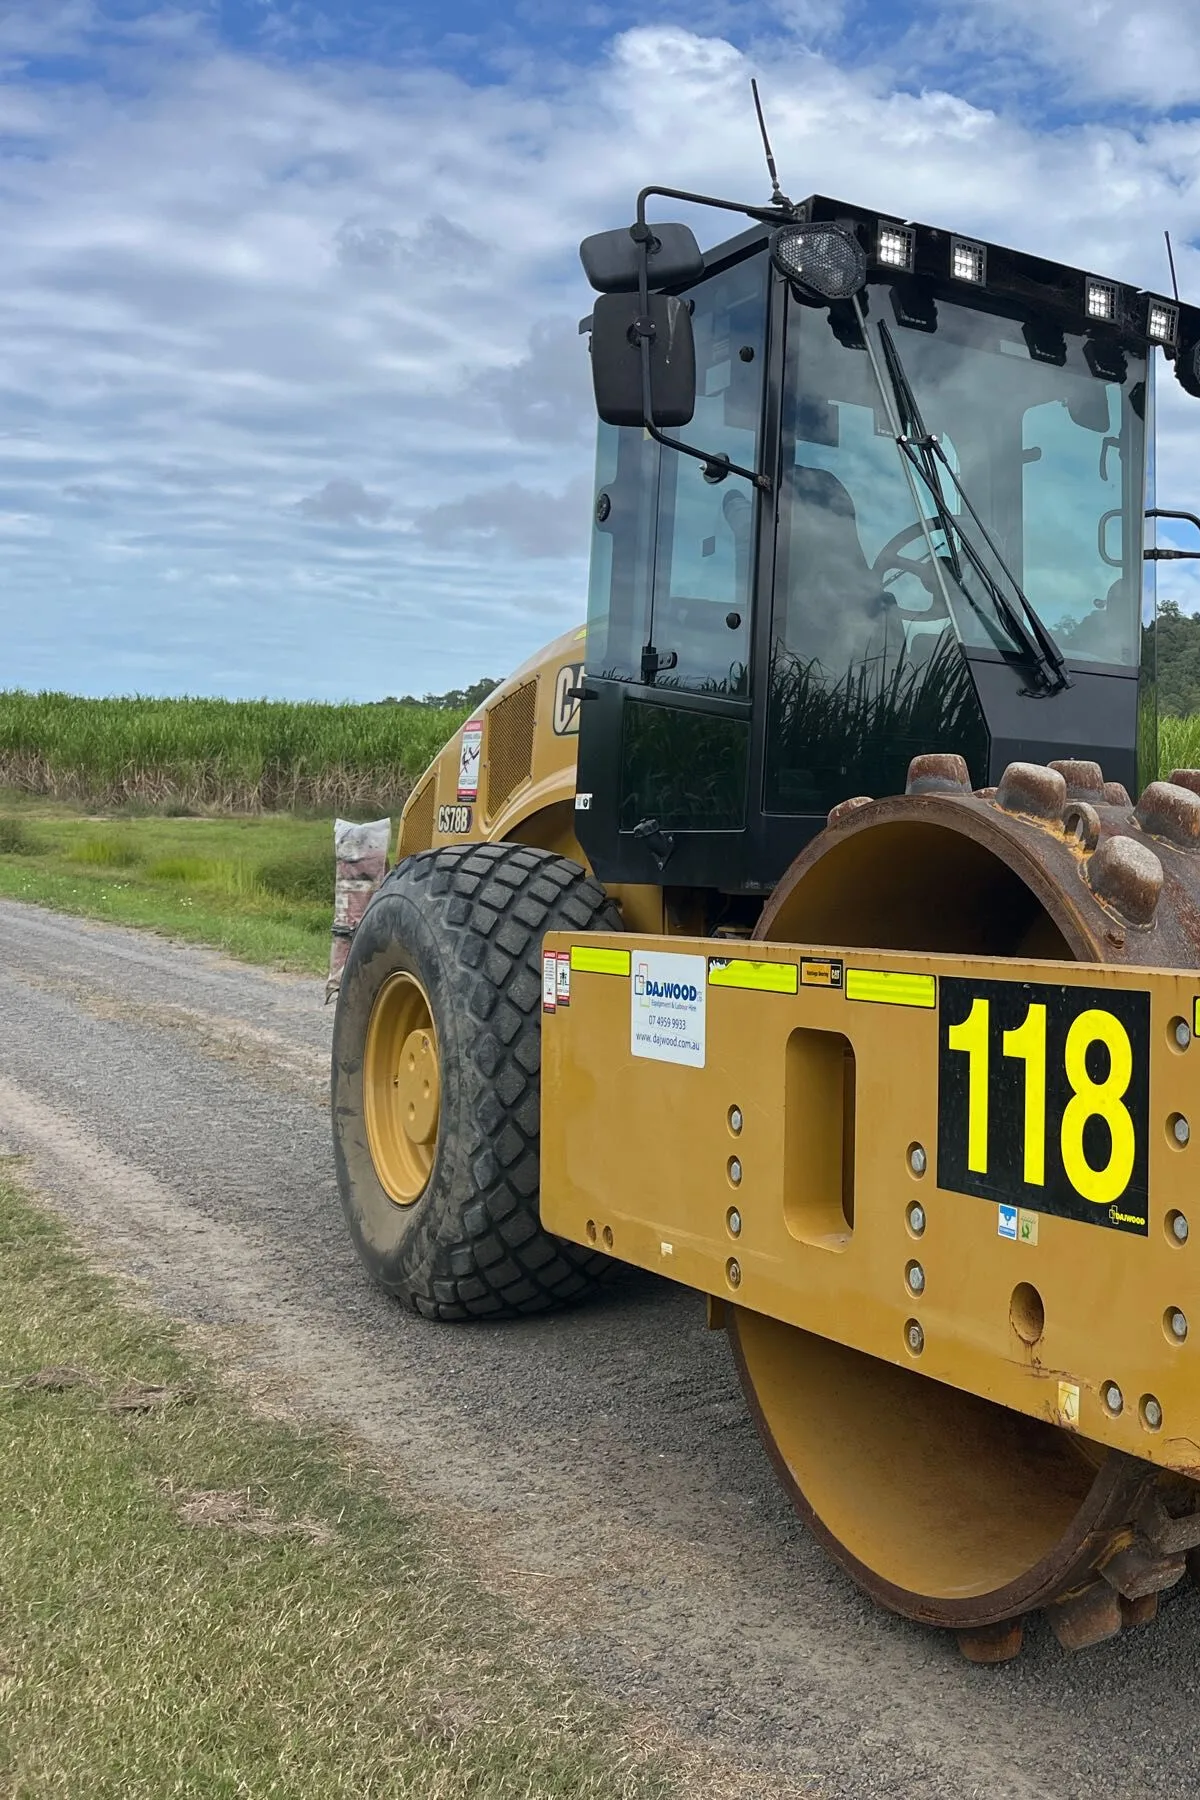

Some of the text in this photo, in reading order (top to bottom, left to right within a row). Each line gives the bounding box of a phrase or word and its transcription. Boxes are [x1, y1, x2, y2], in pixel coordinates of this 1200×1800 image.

[438, 805, 469, 832] CS78B
[649, 1015, 686, 1030] 07 4959 9933
[949, 998, 1136, 1204] 118
